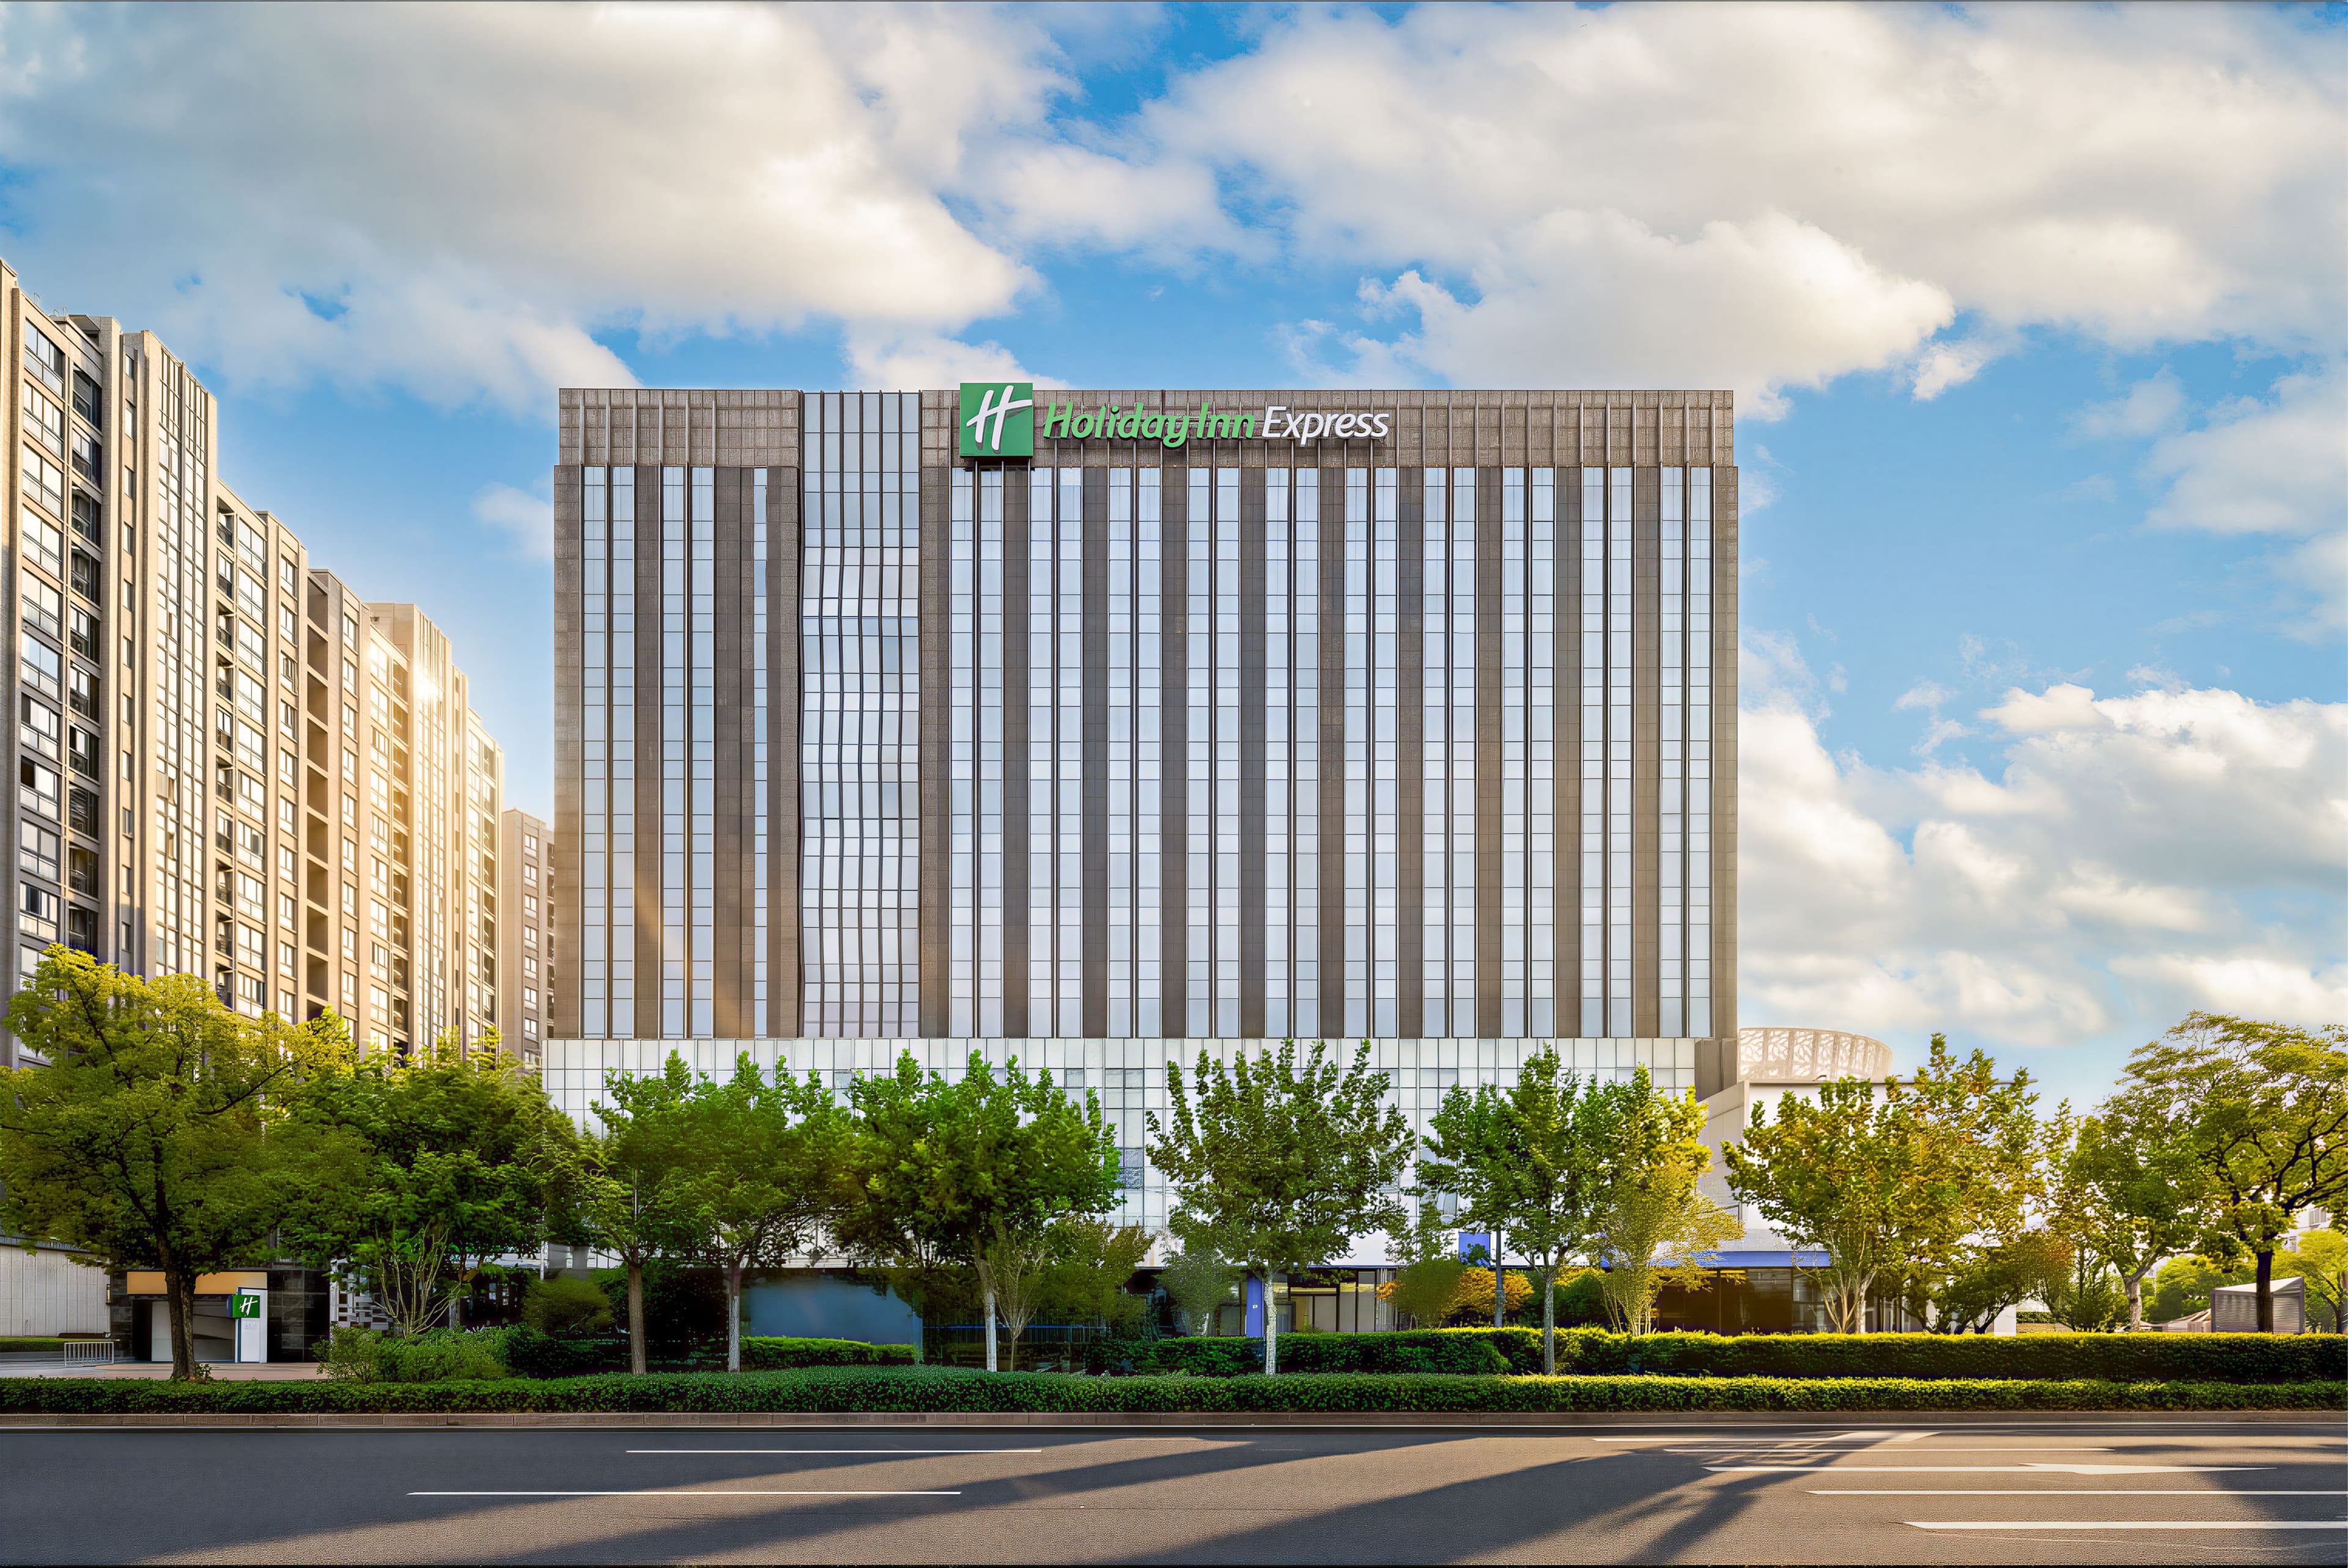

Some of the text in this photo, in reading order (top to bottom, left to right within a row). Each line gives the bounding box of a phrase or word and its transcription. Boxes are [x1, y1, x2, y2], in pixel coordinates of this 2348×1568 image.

[966, 385, 1033, 451] H
[1043, 401, 1390, 447] Holiday Inn Express
